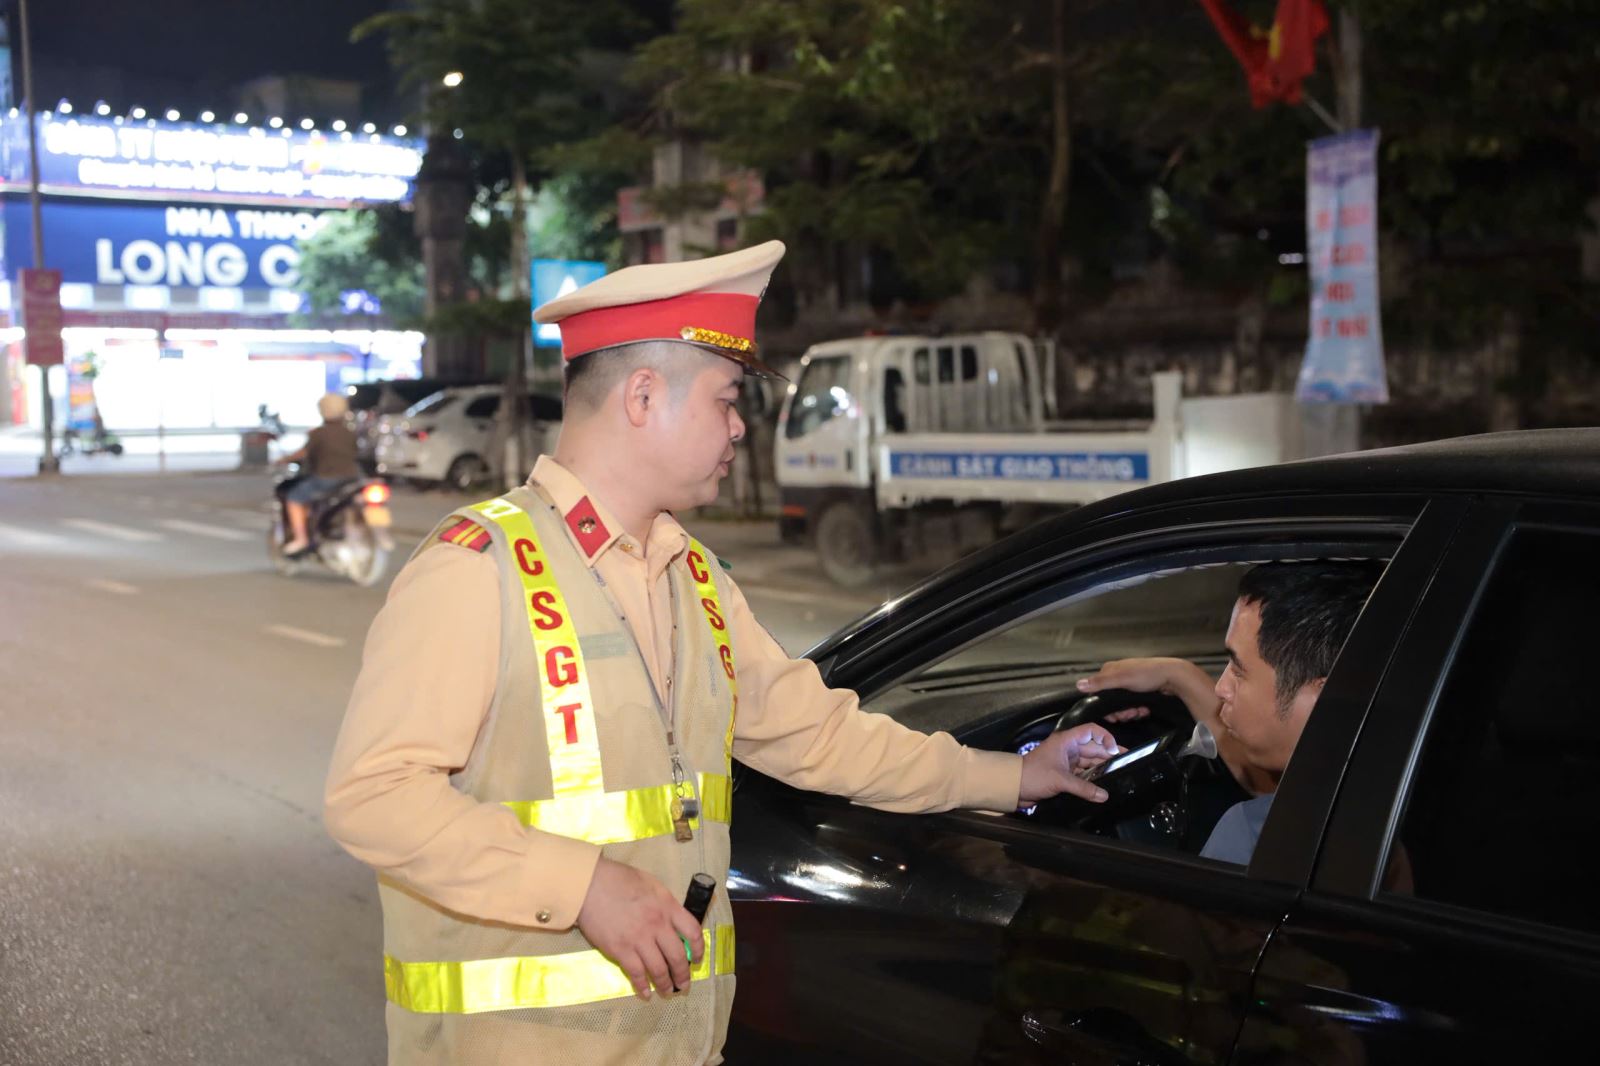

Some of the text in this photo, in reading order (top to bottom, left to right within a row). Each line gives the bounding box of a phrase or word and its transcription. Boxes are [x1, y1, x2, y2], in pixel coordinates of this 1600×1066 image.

[96, 238, 249, 287] LONG
[1000, 455, 1054, 480] GIAO
[513, 538, 583, 745] CSGT
[686, 550, 738, 733] CSG
